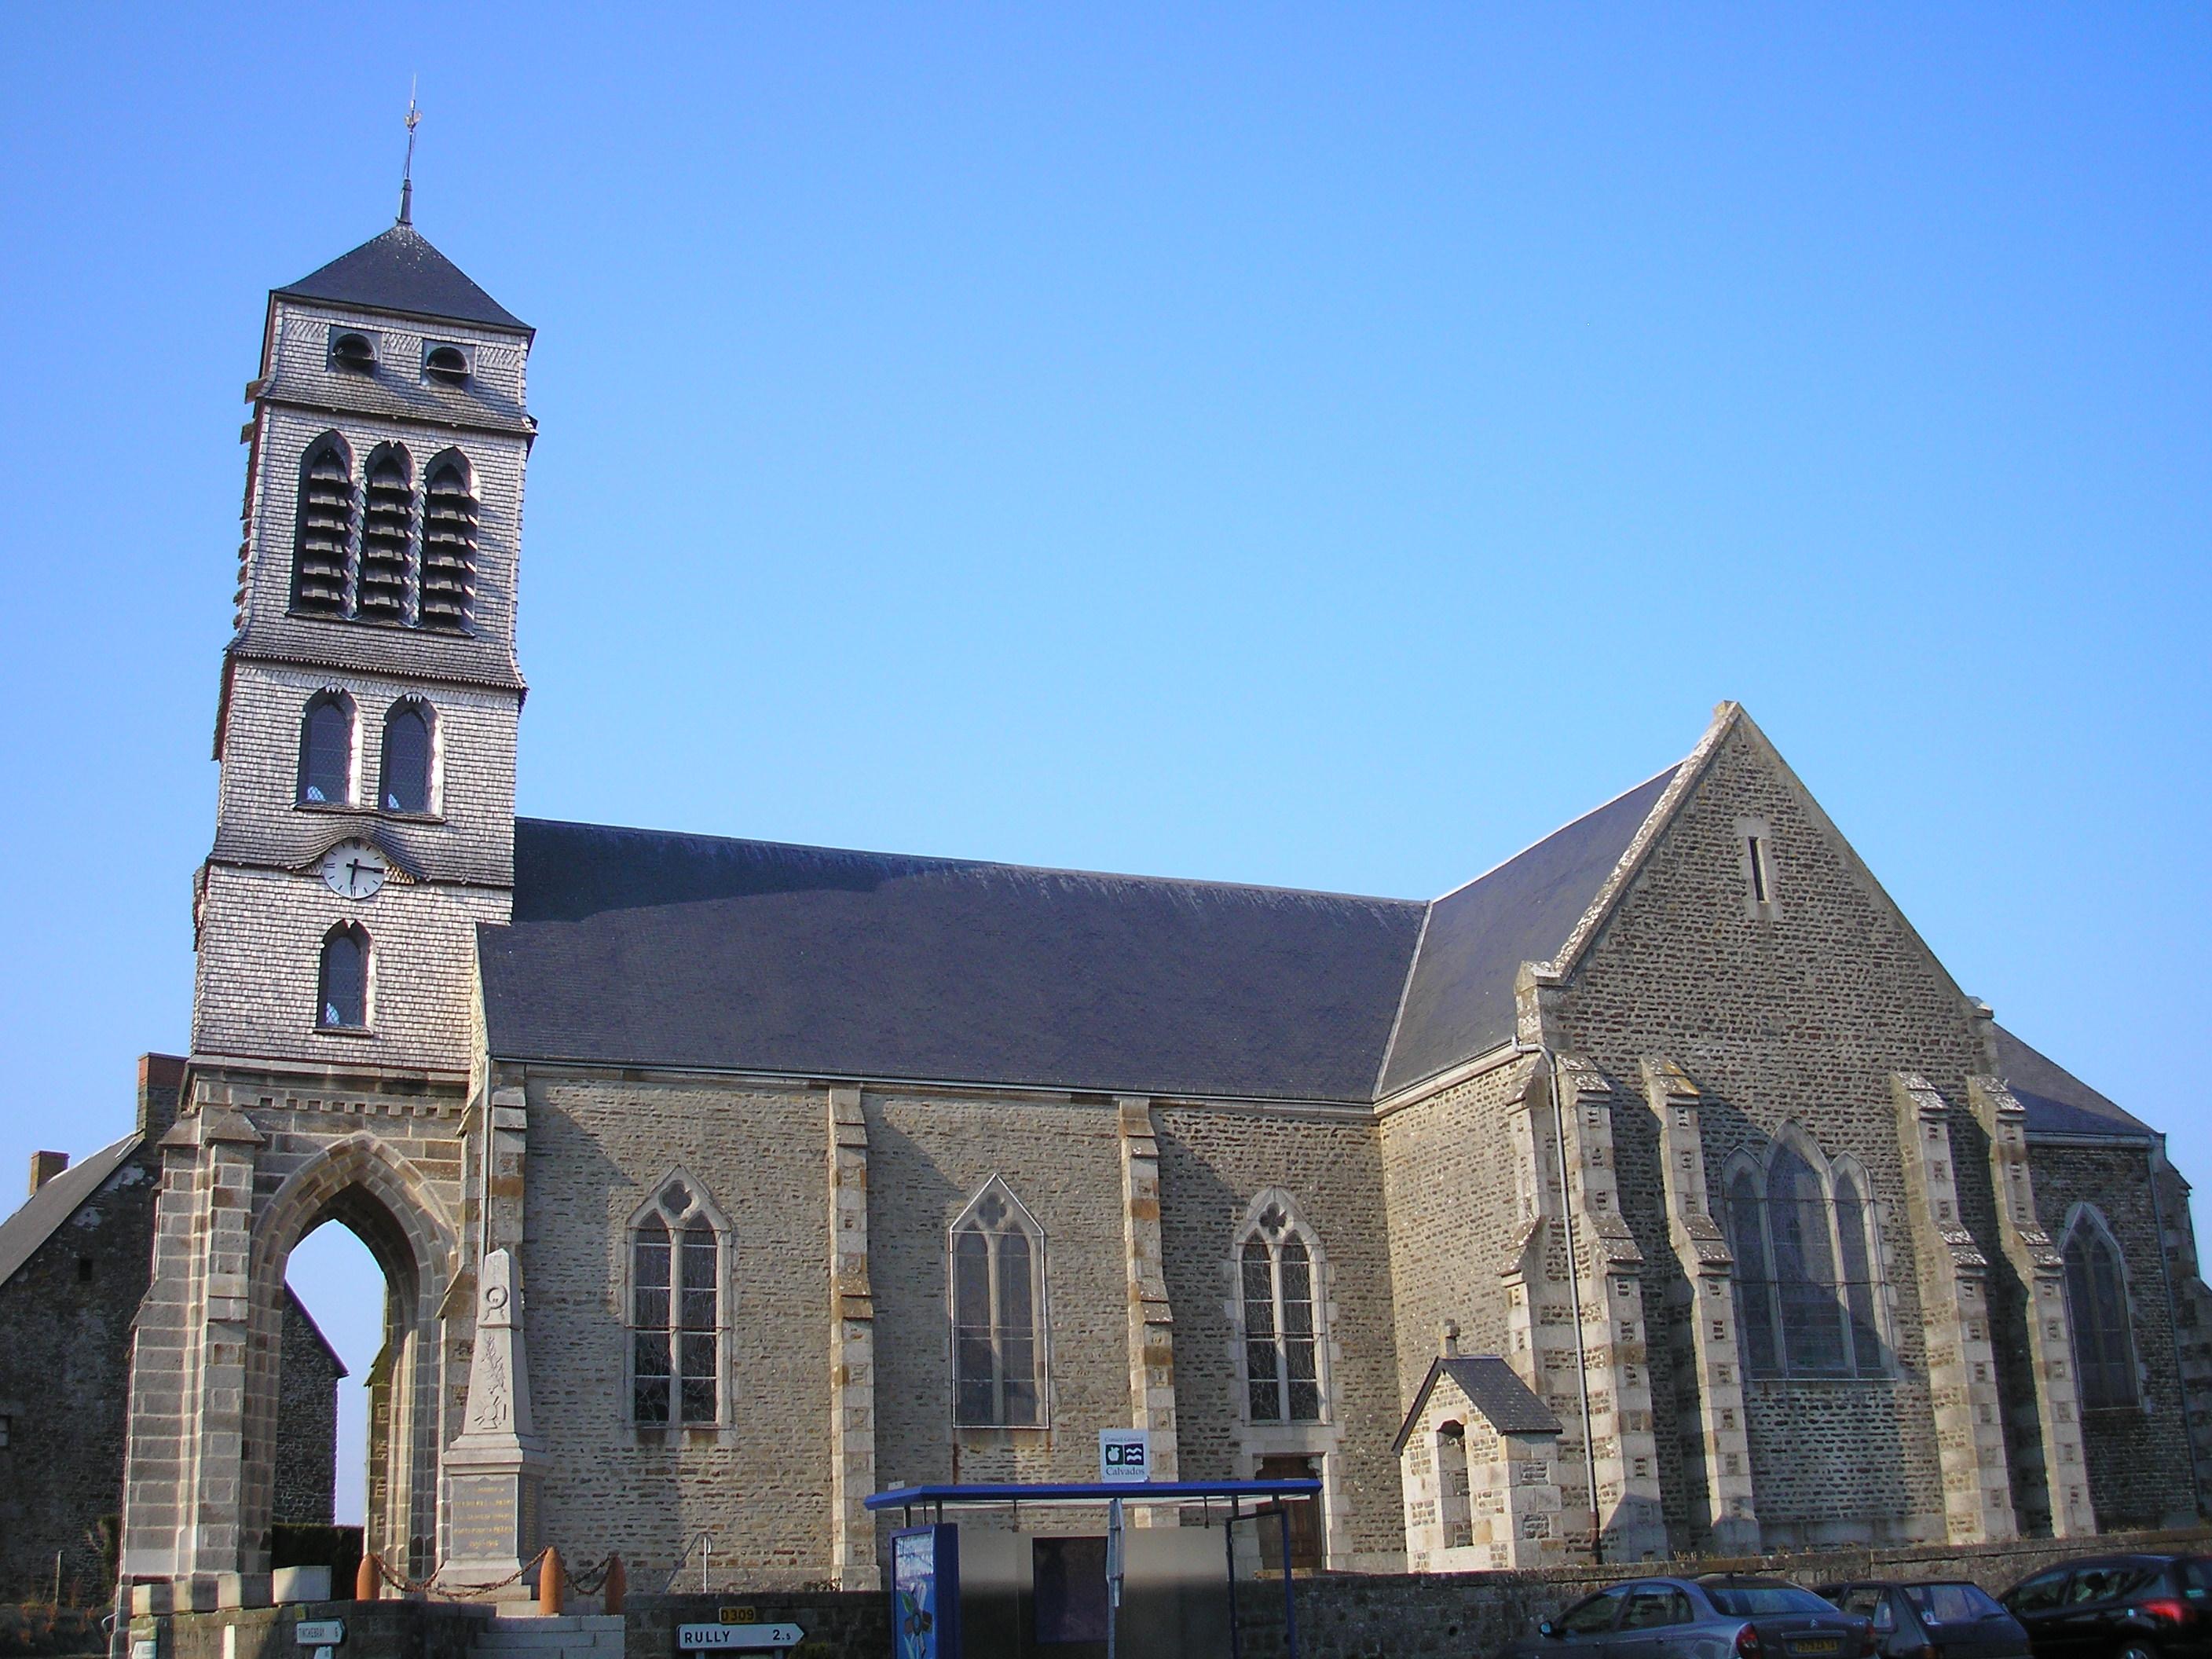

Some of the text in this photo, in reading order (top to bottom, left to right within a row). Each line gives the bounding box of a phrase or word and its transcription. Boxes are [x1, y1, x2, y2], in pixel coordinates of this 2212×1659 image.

[1106, 1467, 1144, 1476] Calvados
[721, 1610, 754, 1621] D309
[685, 1629, 791, 1643] RULLY 2.5
